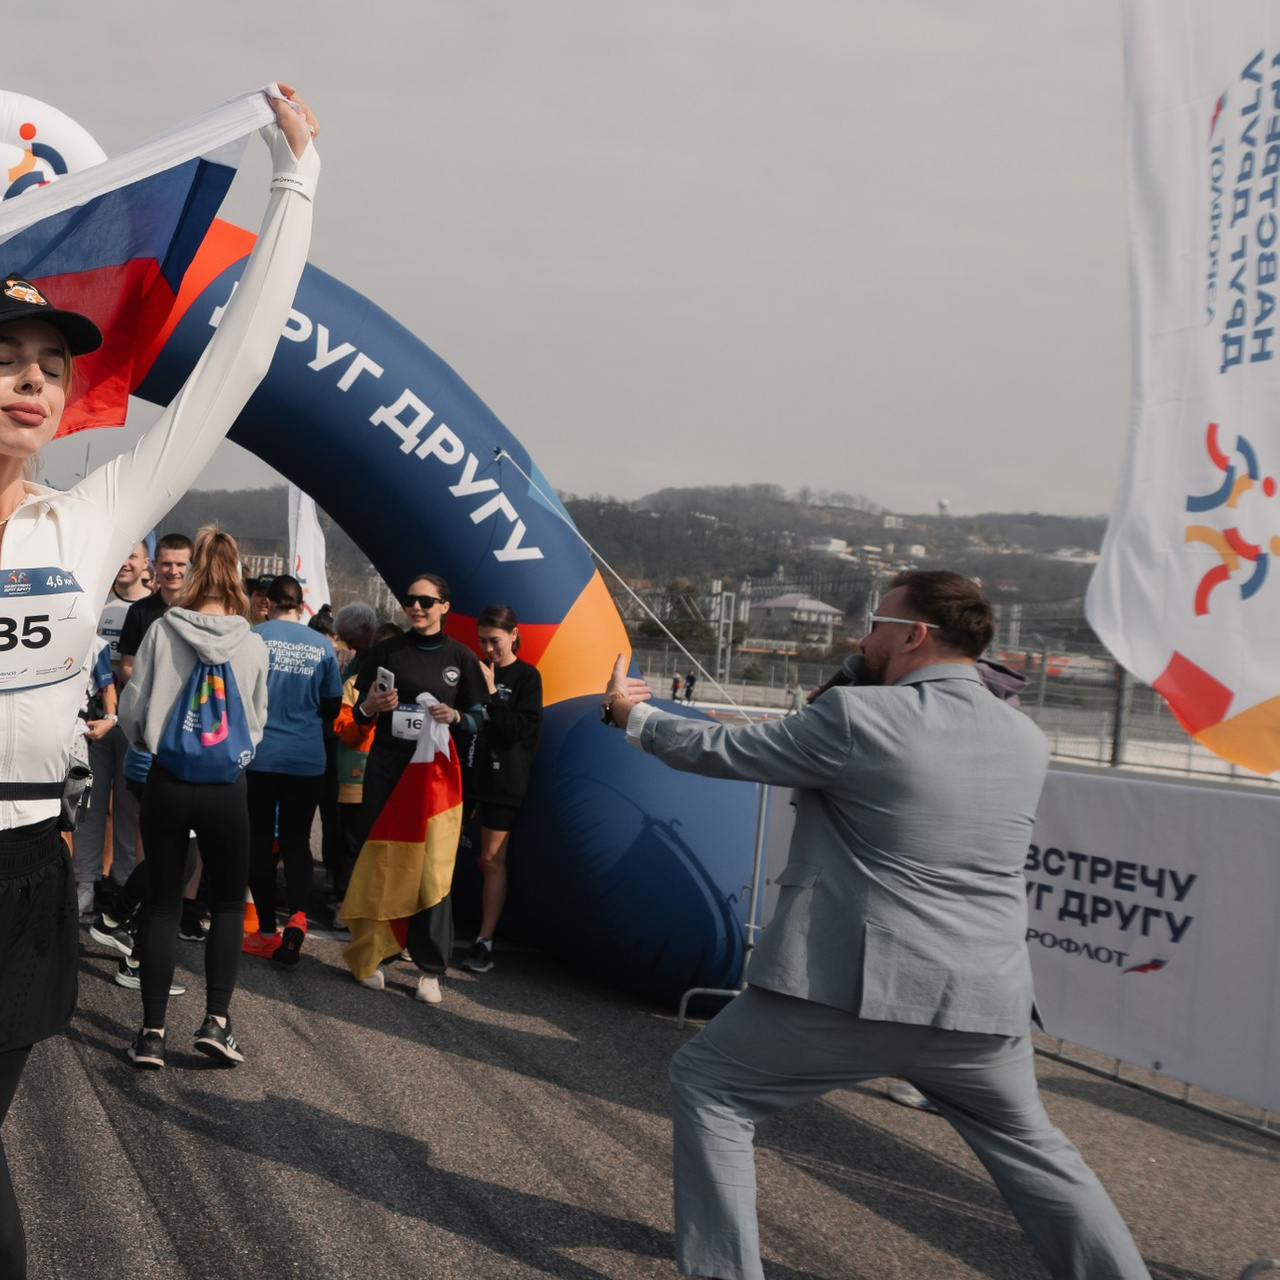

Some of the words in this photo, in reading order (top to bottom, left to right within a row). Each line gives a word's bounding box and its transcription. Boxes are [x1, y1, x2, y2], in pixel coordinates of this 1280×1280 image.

[208, 281, 385, 393] РУГ
[369, 388, 544, 562] ДРУГУ
[46, 575, 63, 588] 4,6
[1023, 843, 1198, 903] ВСТРЕЧУ
[1058, 888, 1195, 944] ДРУГУ
[1025, 927, 1130, 968] РОФЛОТ
